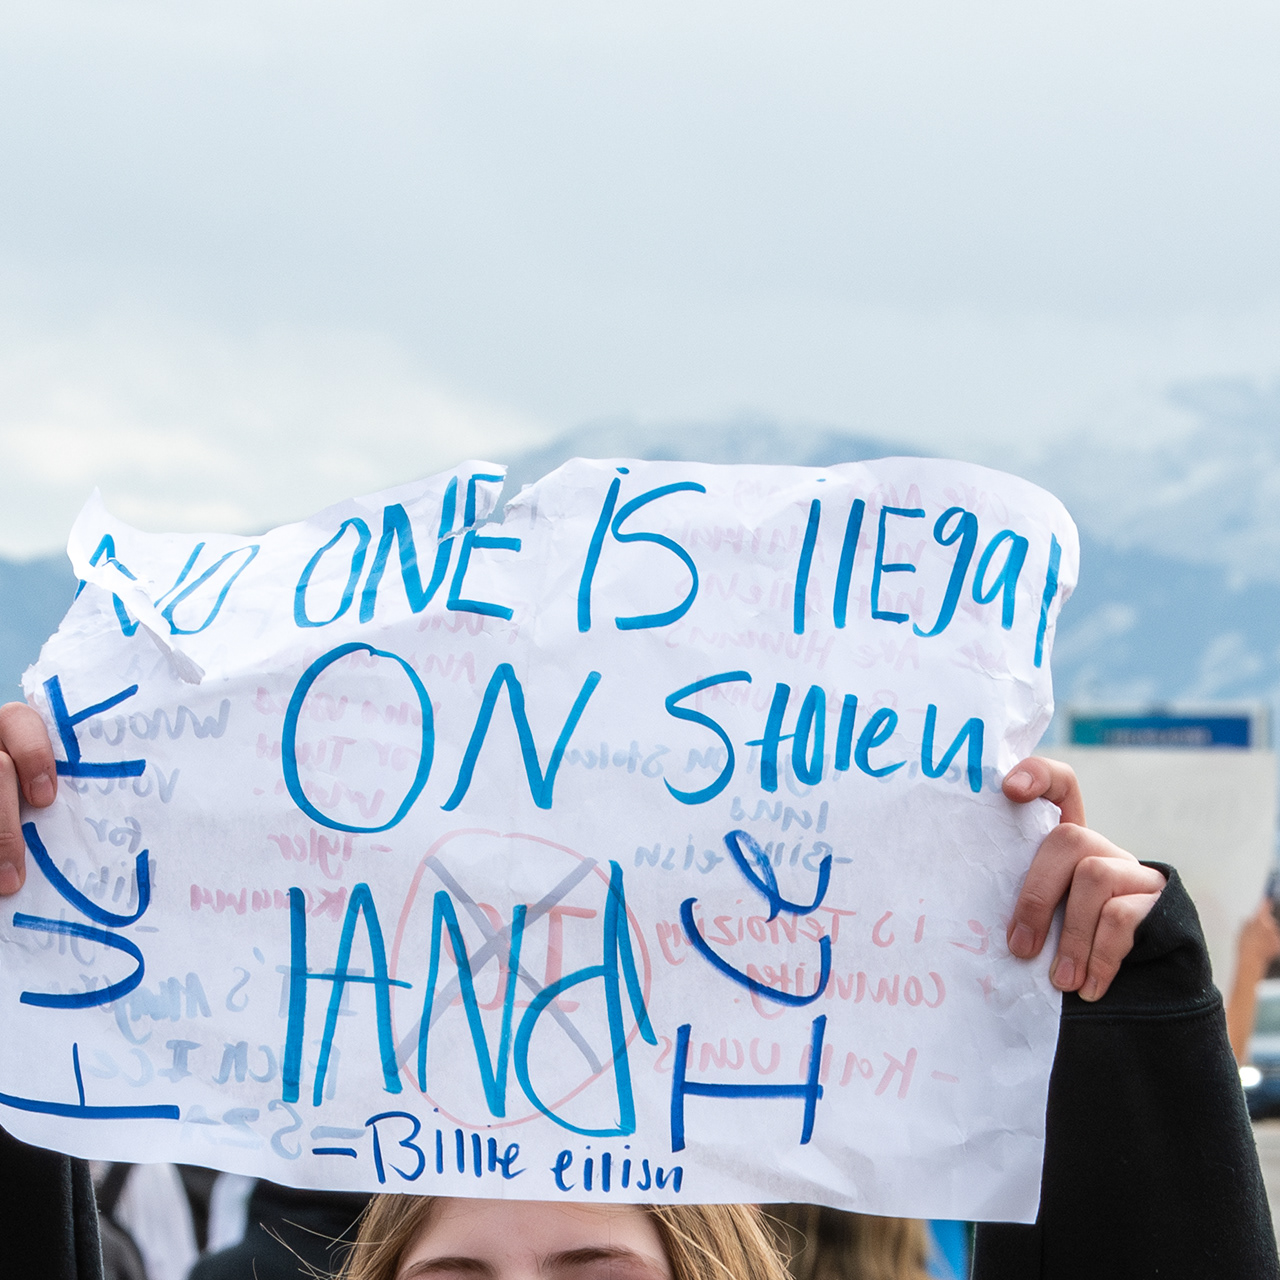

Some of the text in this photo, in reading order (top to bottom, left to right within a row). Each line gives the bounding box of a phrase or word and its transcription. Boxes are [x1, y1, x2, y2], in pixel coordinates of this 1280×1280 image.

[294, 473, 522, 628] ONE
[282, 642, 985, 833] ON Stolen
